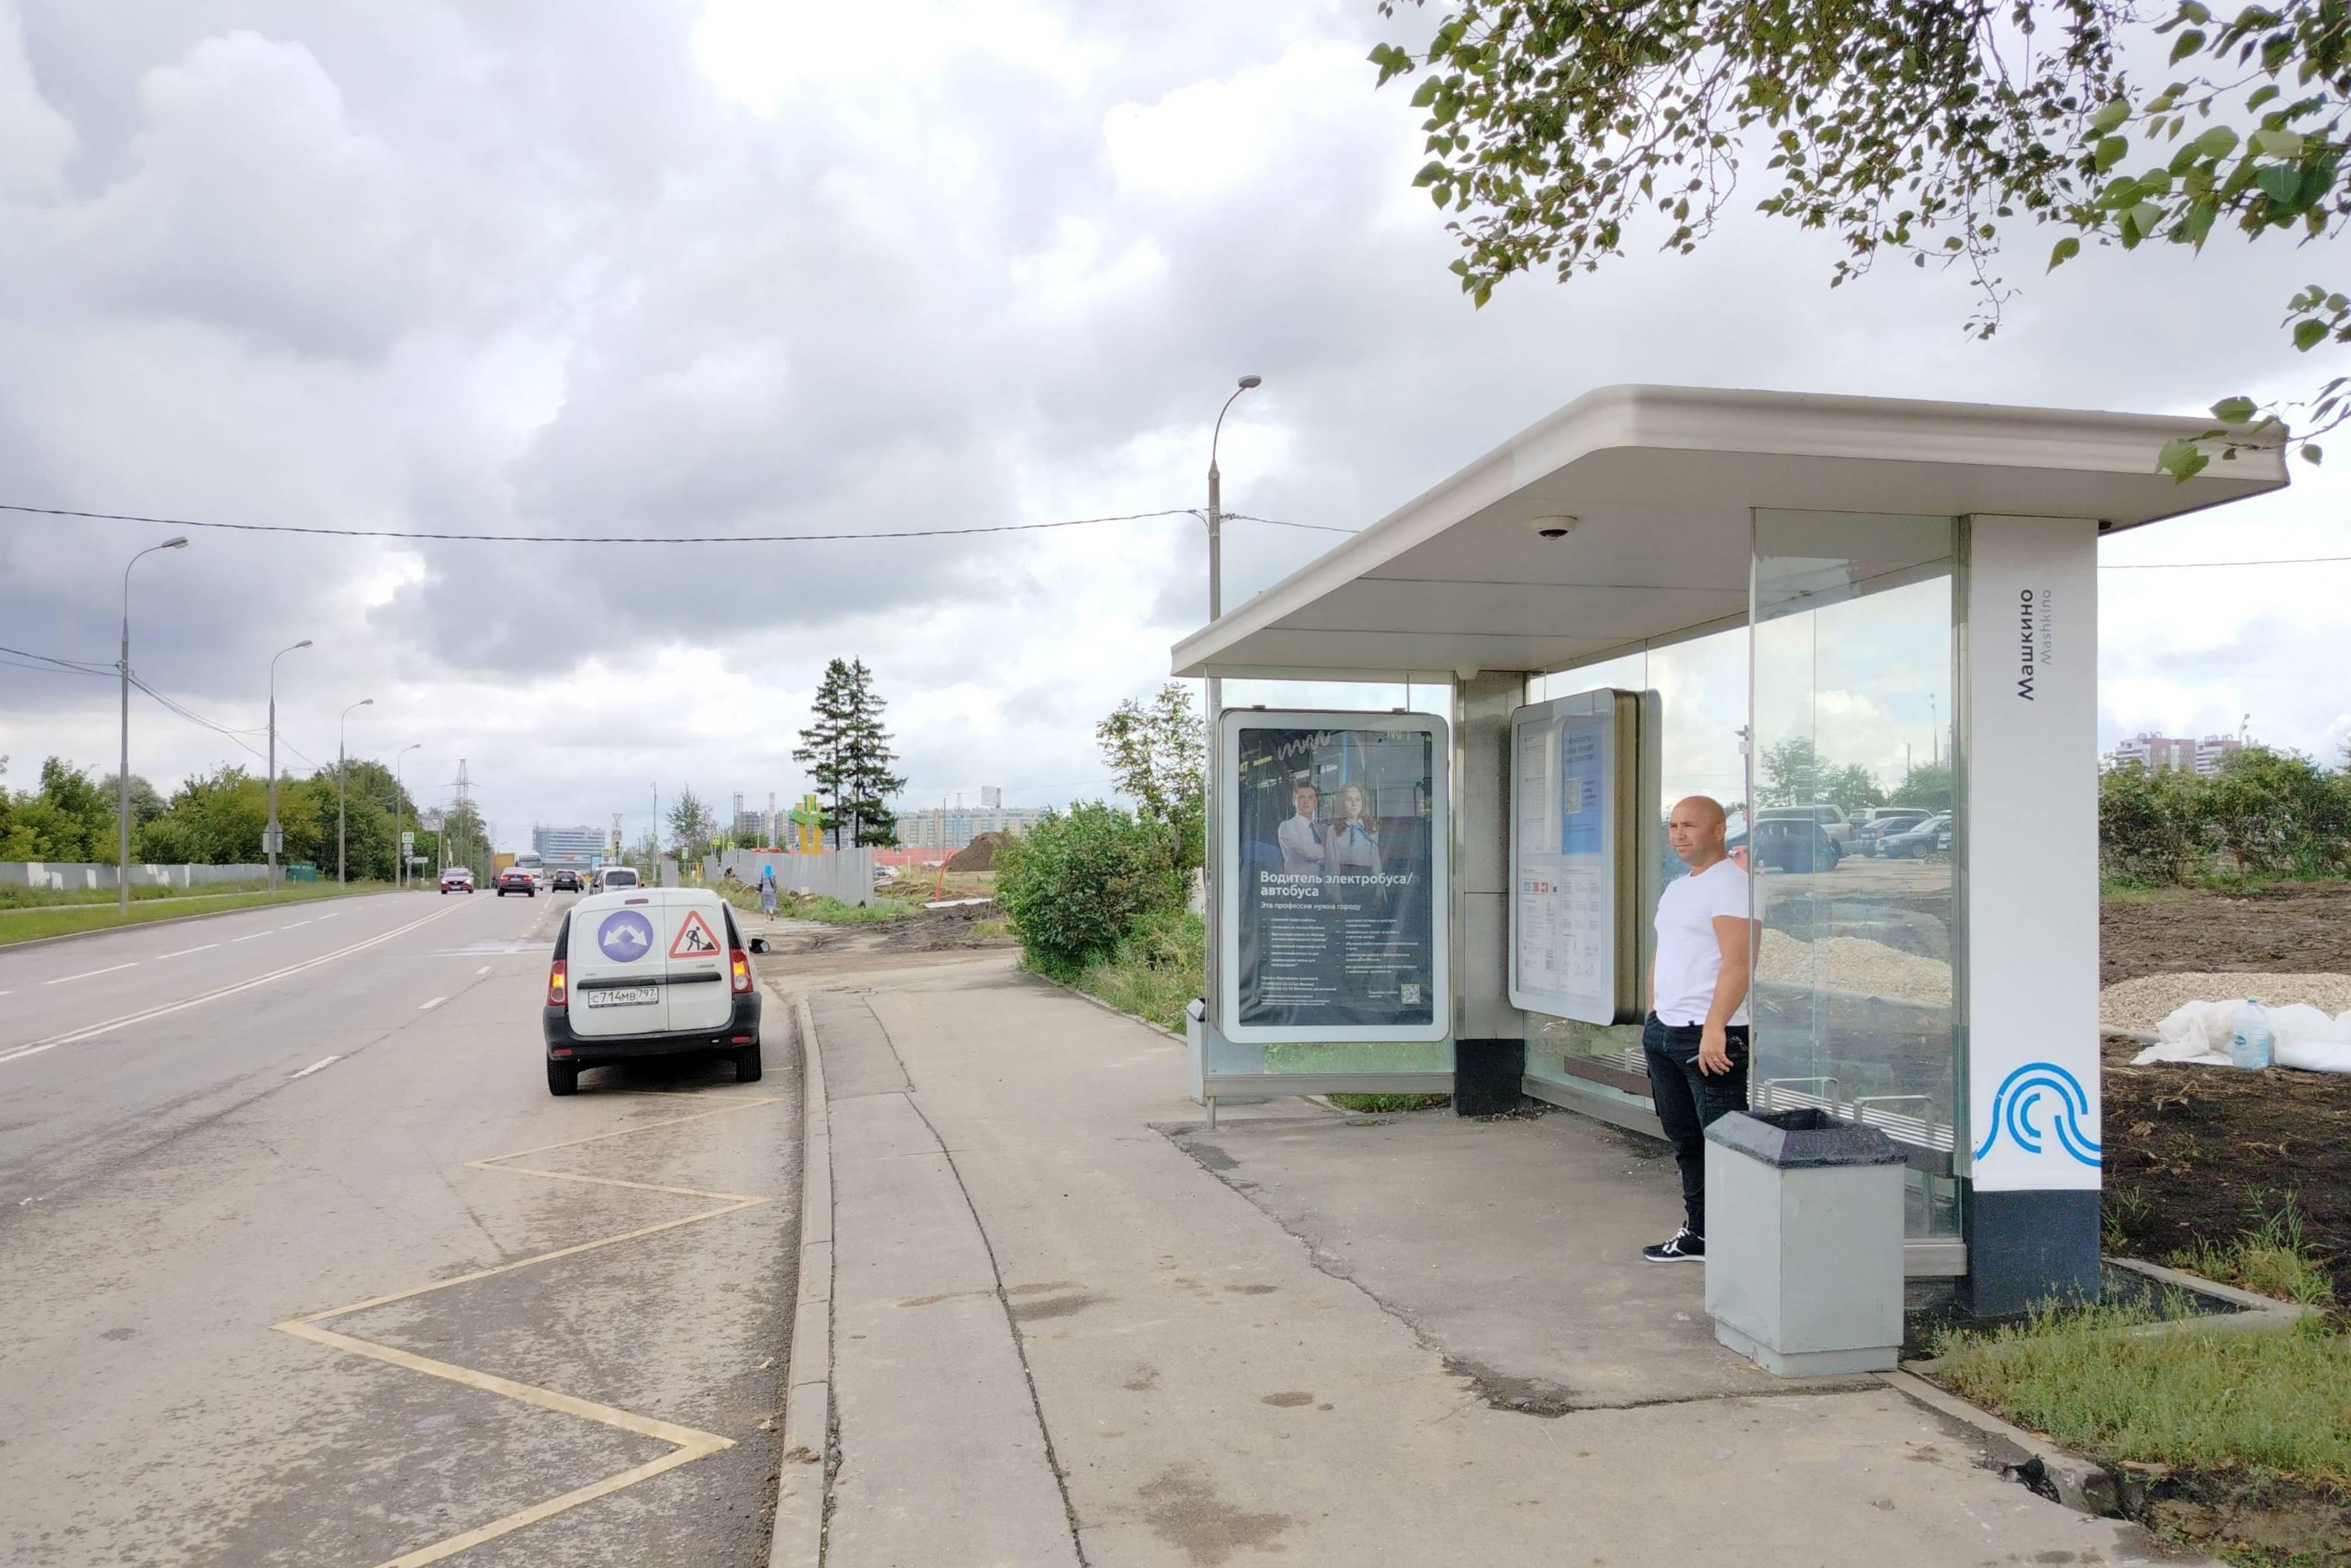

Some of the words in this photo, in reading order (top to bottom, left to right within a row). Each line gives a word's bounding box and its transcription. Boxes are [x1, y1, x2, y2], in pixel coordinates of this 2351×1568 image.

[2039, 589, 2052, 665] Mashkino
[2017, 589, 2034, 701] Машкино
[1260, 871, 1322, 885] Водитель
[1326, 872, 1414, 887] электробуса/
[1260, 885, 1319, 899] автобуса
[1274, 902, 1312, 911] профессия
[638, 988, 655, 998] 797
